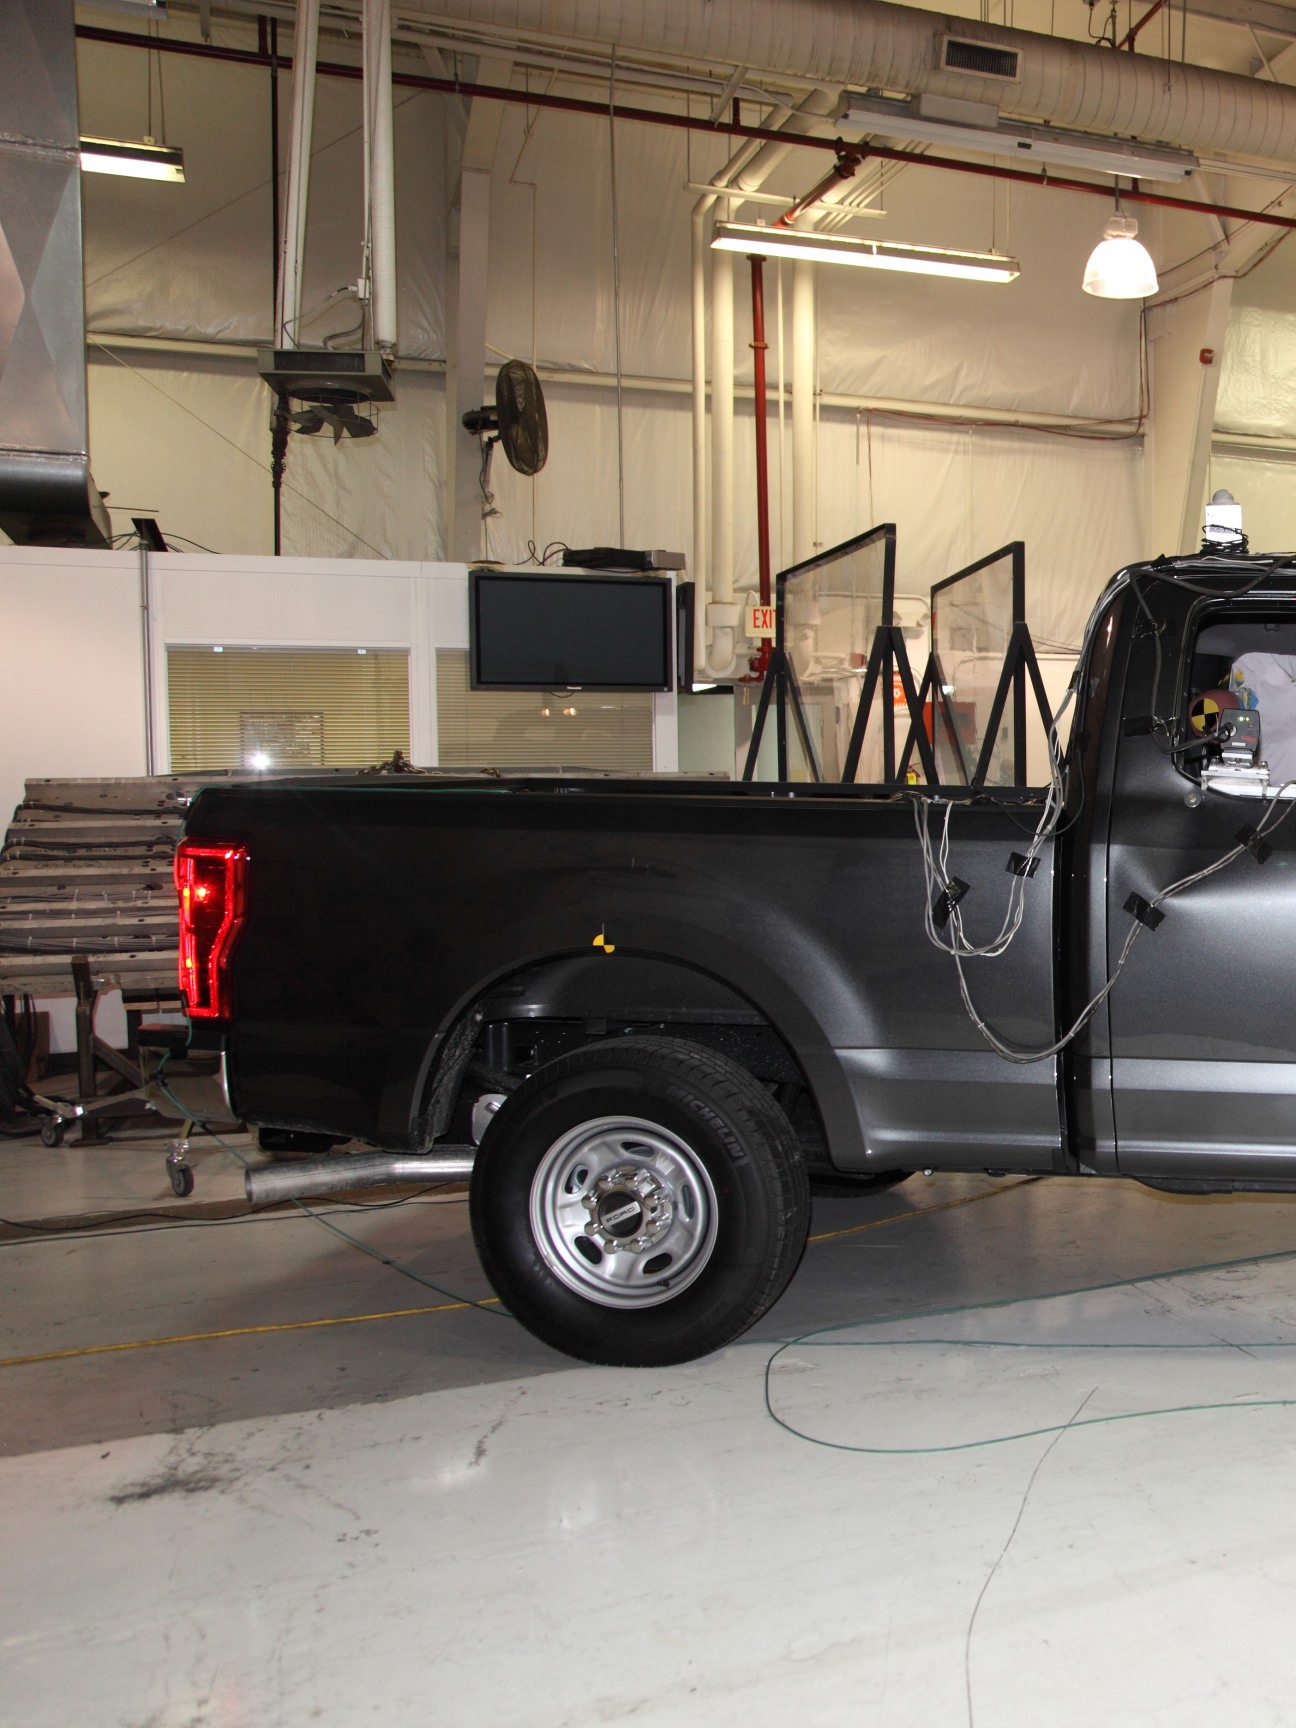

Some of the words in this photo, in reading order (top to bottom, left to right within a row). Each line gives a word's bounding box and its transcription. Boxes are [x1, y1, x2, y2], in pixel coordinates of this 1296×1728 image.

[752, 609, 776, 629] EXI
[665, 1085, 745, 1158] MICHELIN
[606, 1206, 635, 1223] FORD
